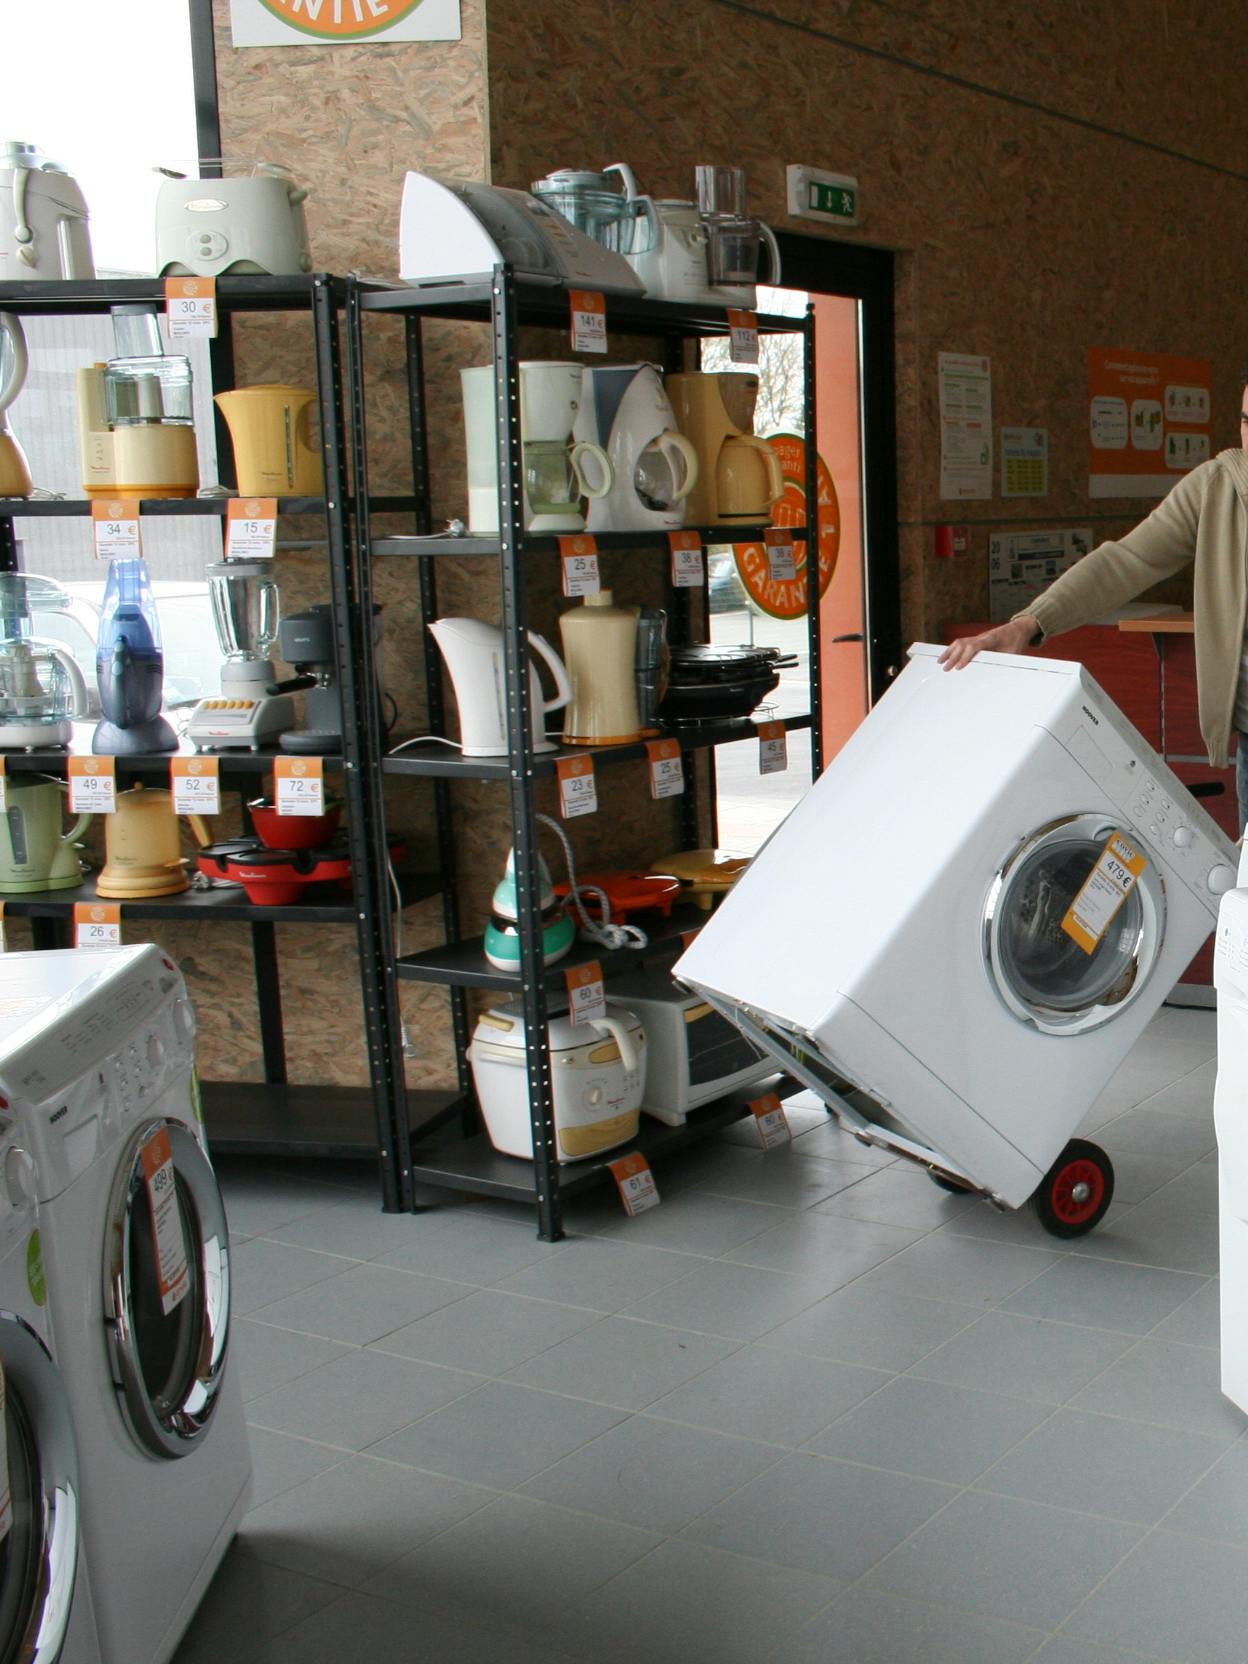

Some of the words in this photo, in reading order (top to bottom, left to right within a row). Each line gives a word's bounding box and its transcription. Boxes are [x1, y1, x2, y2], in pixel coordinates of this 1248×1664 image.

[279, 0, 389, 24] NTIE
[181, 301, 196, 314] 30
[580, 314, 595, 328] 141
[107, 523, 121, 535] 34
[244, 522, 258, 533] 15
[574, 558, 586, 570] 25
[661, 762, 671, 774] 25
[83, 779, 98, 790] 49
[186, 779, 200, 790] 52
[289, 780, 304, 791] 72
[572, 780, 583, 791] 23
[90, 926, 104, 937] 26
[580, 987, 592, 999] 60
[153, 1167, 168, 1191] 499
